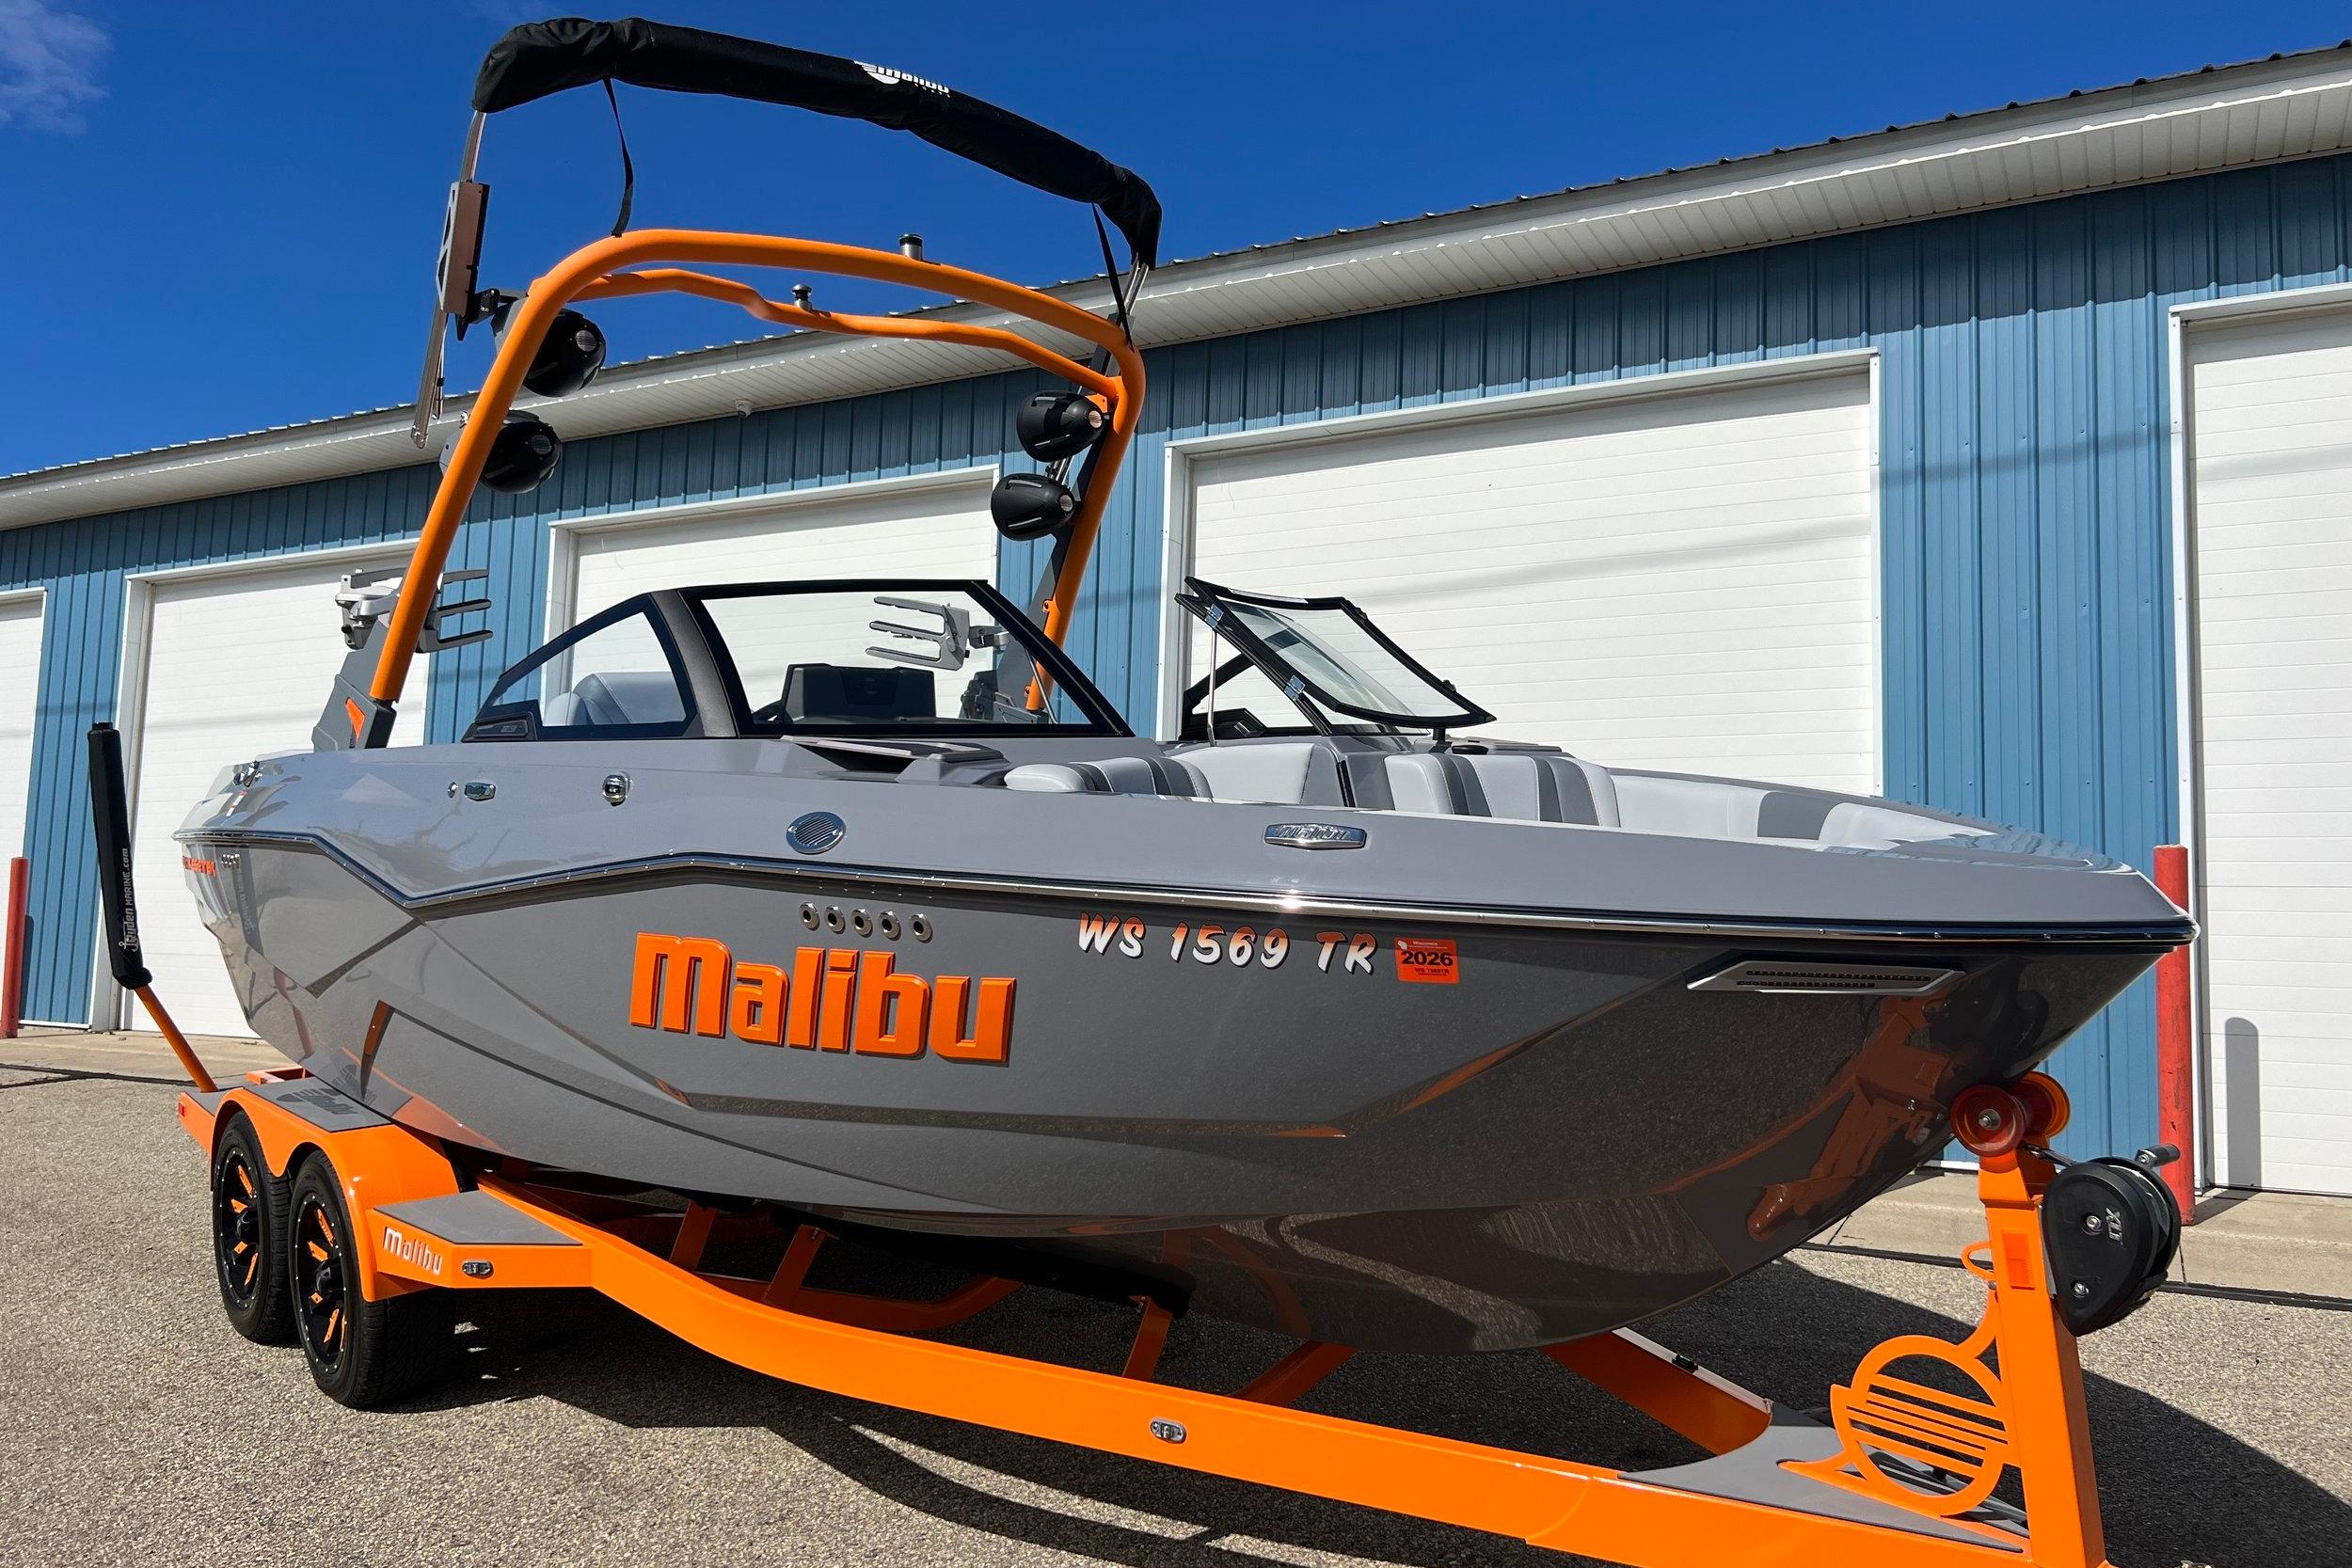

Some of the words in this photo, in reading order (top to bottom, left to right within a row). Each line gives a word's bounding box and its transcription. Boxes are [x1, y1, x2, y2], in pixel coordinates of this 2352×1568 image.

[1078, 911, 1146, 958] WS
[1170, 921, 1290, 969] 1569
[1315, 930, 1378, 975] TR
[1401, 950, 1454, 967] 2026
[629, 932, 1017, 1067] Malibu
[383, 1227, 443, 1275] Malibu
